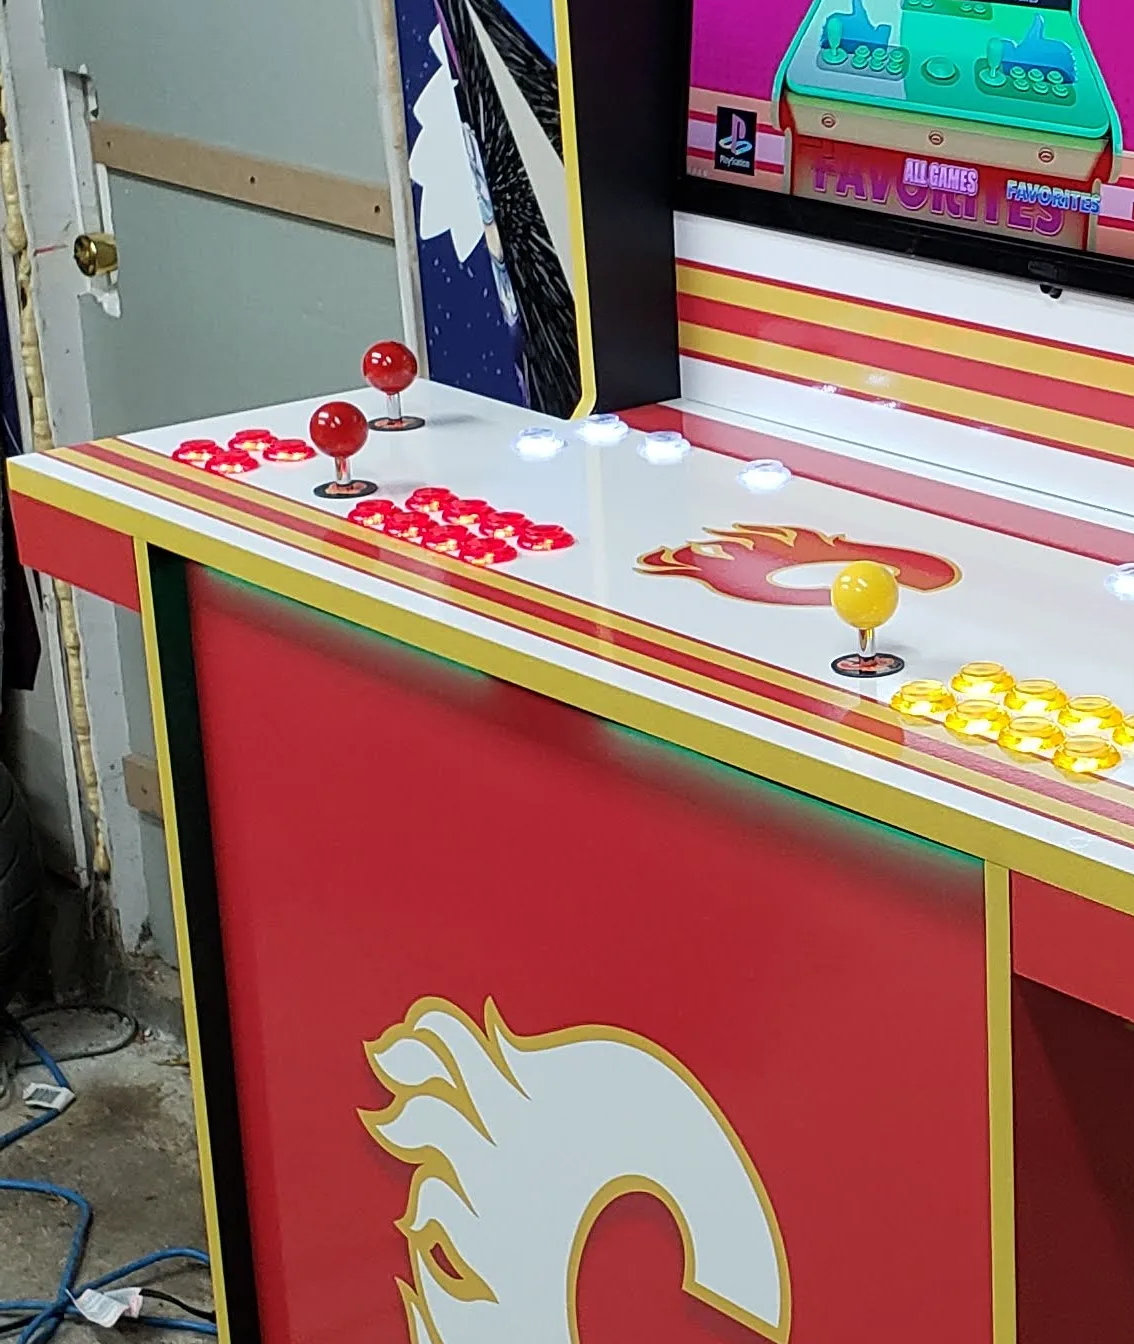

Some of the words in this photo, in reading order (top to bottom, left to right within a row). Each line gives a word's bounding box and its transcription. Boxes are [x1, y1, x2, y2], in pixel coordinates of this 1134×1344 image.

[903, 157, 928, 186] ALL
[928, 163, 979, 197] GAMES
[1005, 179, 1101, 215] FAVORITES
